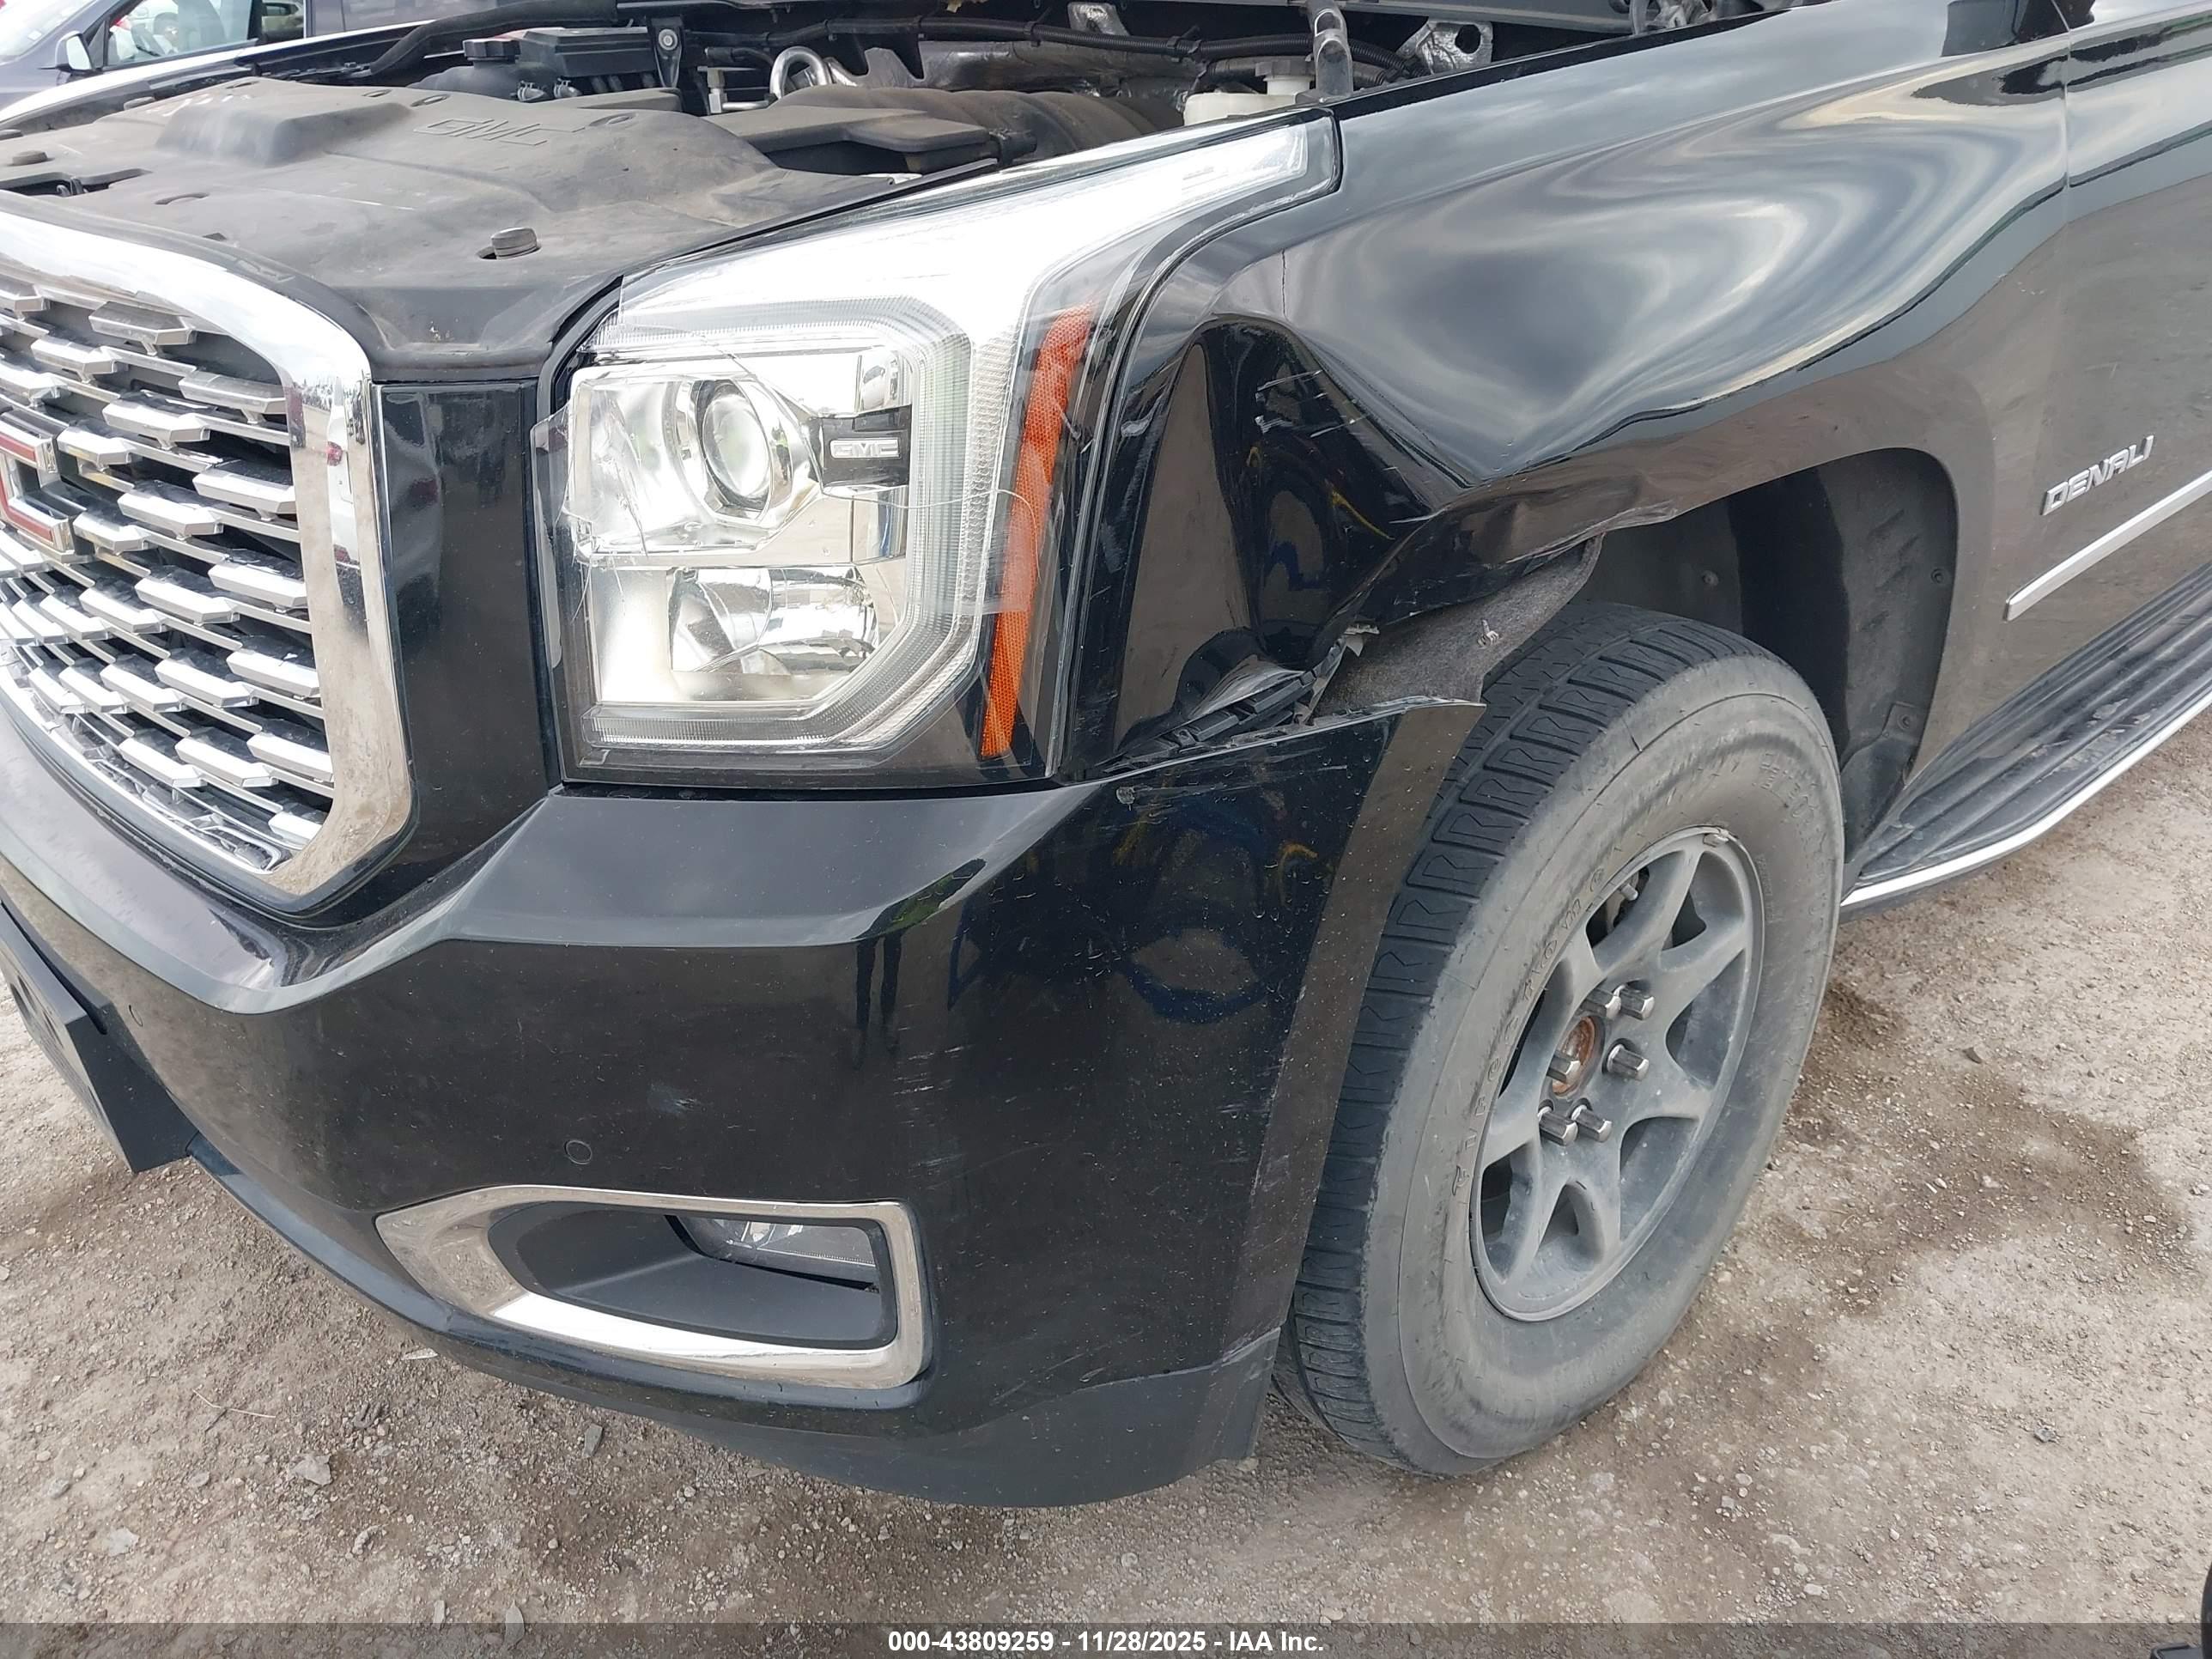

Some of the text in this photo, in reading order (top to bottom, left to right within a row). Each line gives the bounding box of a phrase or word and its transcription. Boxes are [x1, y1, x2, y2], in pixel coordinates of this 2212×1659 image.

[414, 118, 586, 146] GMC
[830, 438, 900, 459] GMC
[2040, 434, 2154, 516] DENALI
